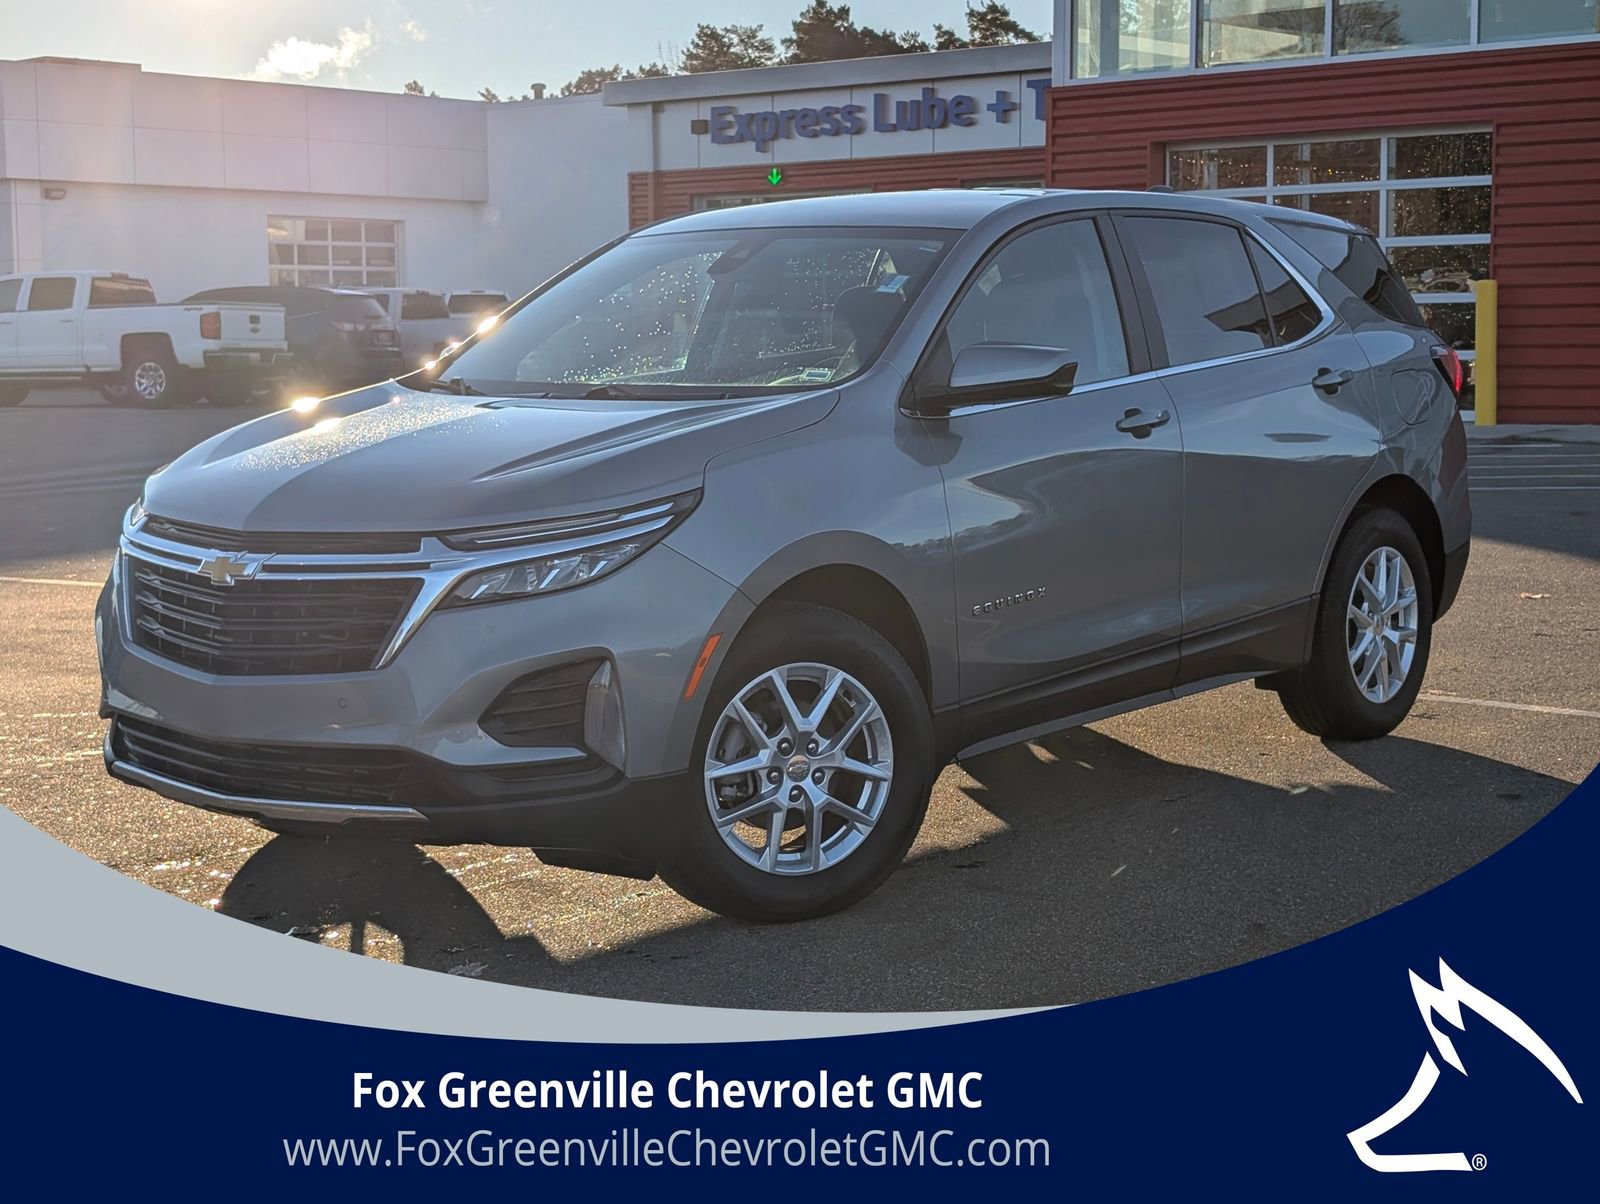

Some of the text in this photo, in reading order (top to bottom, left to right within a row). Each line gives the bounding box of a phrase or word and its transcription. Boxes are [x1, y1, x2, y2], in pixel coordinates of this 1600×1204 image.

[710, 103, 864, 153] Express
[872, 87, 976, 134] Lube
[971, 586, 1047, 617] EQUINOX
